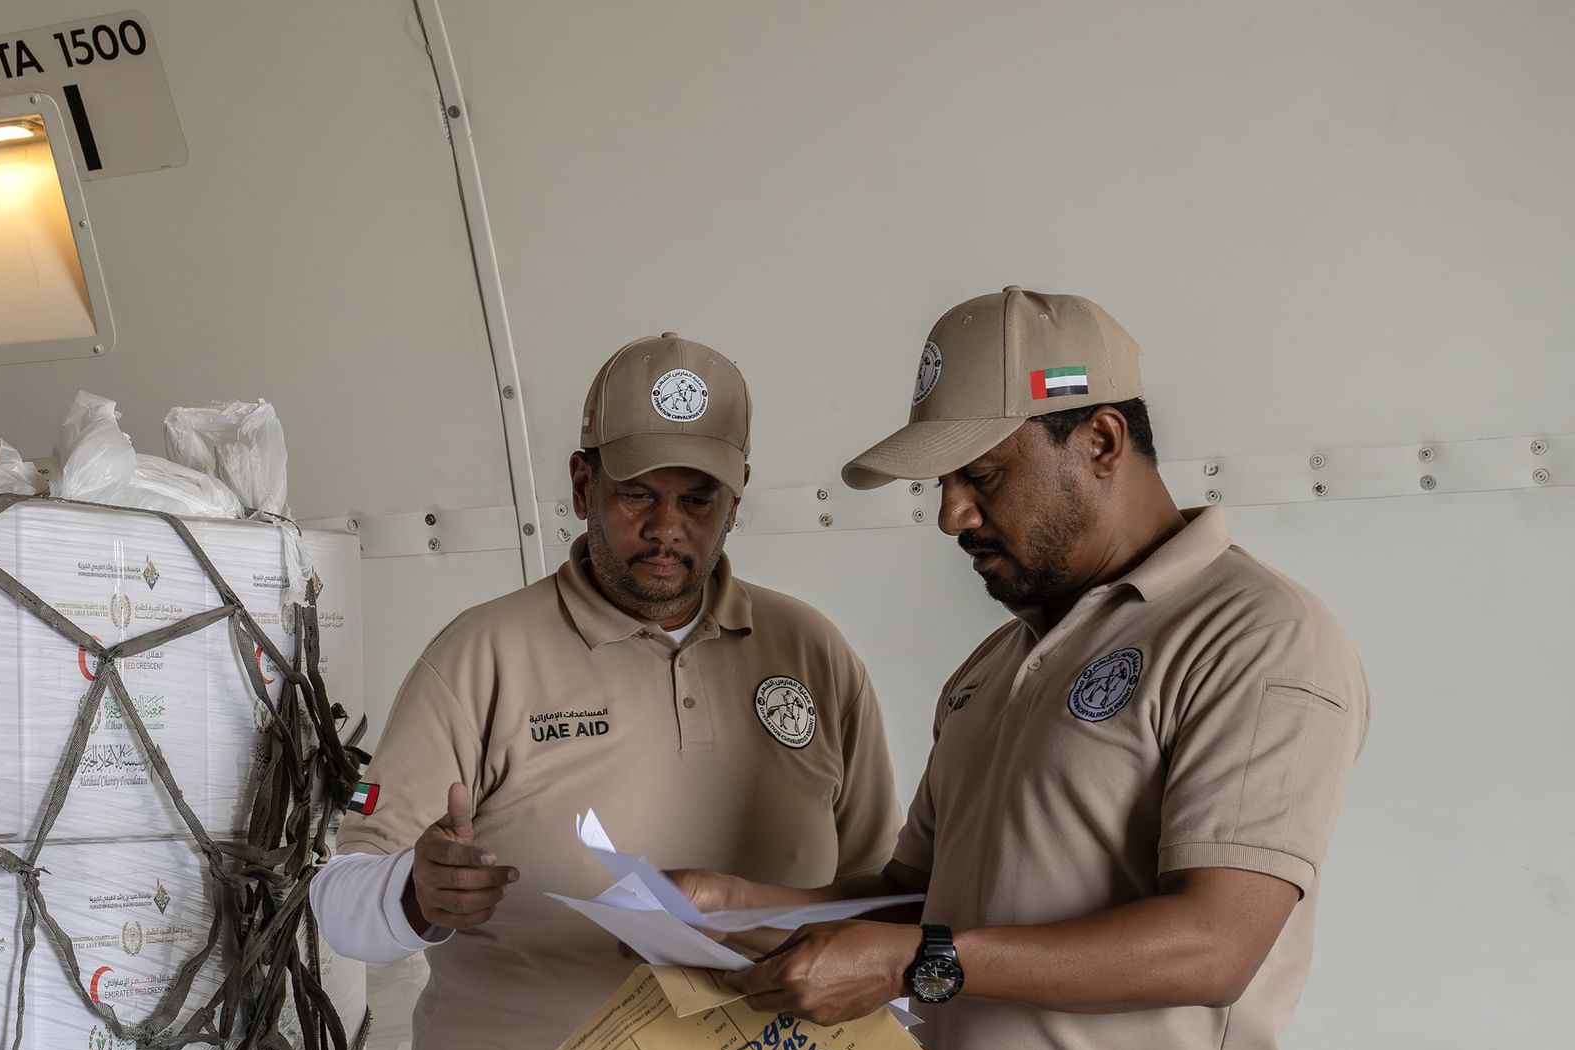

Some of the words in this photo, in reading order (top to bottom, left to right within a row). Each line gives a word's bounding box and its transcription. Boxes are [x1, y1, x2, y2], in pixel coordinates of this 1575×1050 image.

[53, 18, 148, 69] 1500
[136, 662, 164, 670] CRESCENT
[529, 711, 563, 724] الإماراتية
[563, 708, 609, 720] المساعدات
[530, 722, 571, 742] UAE
[576, 720, 610, 737] AID
[104, 989, 134, 999] EMIRATES
